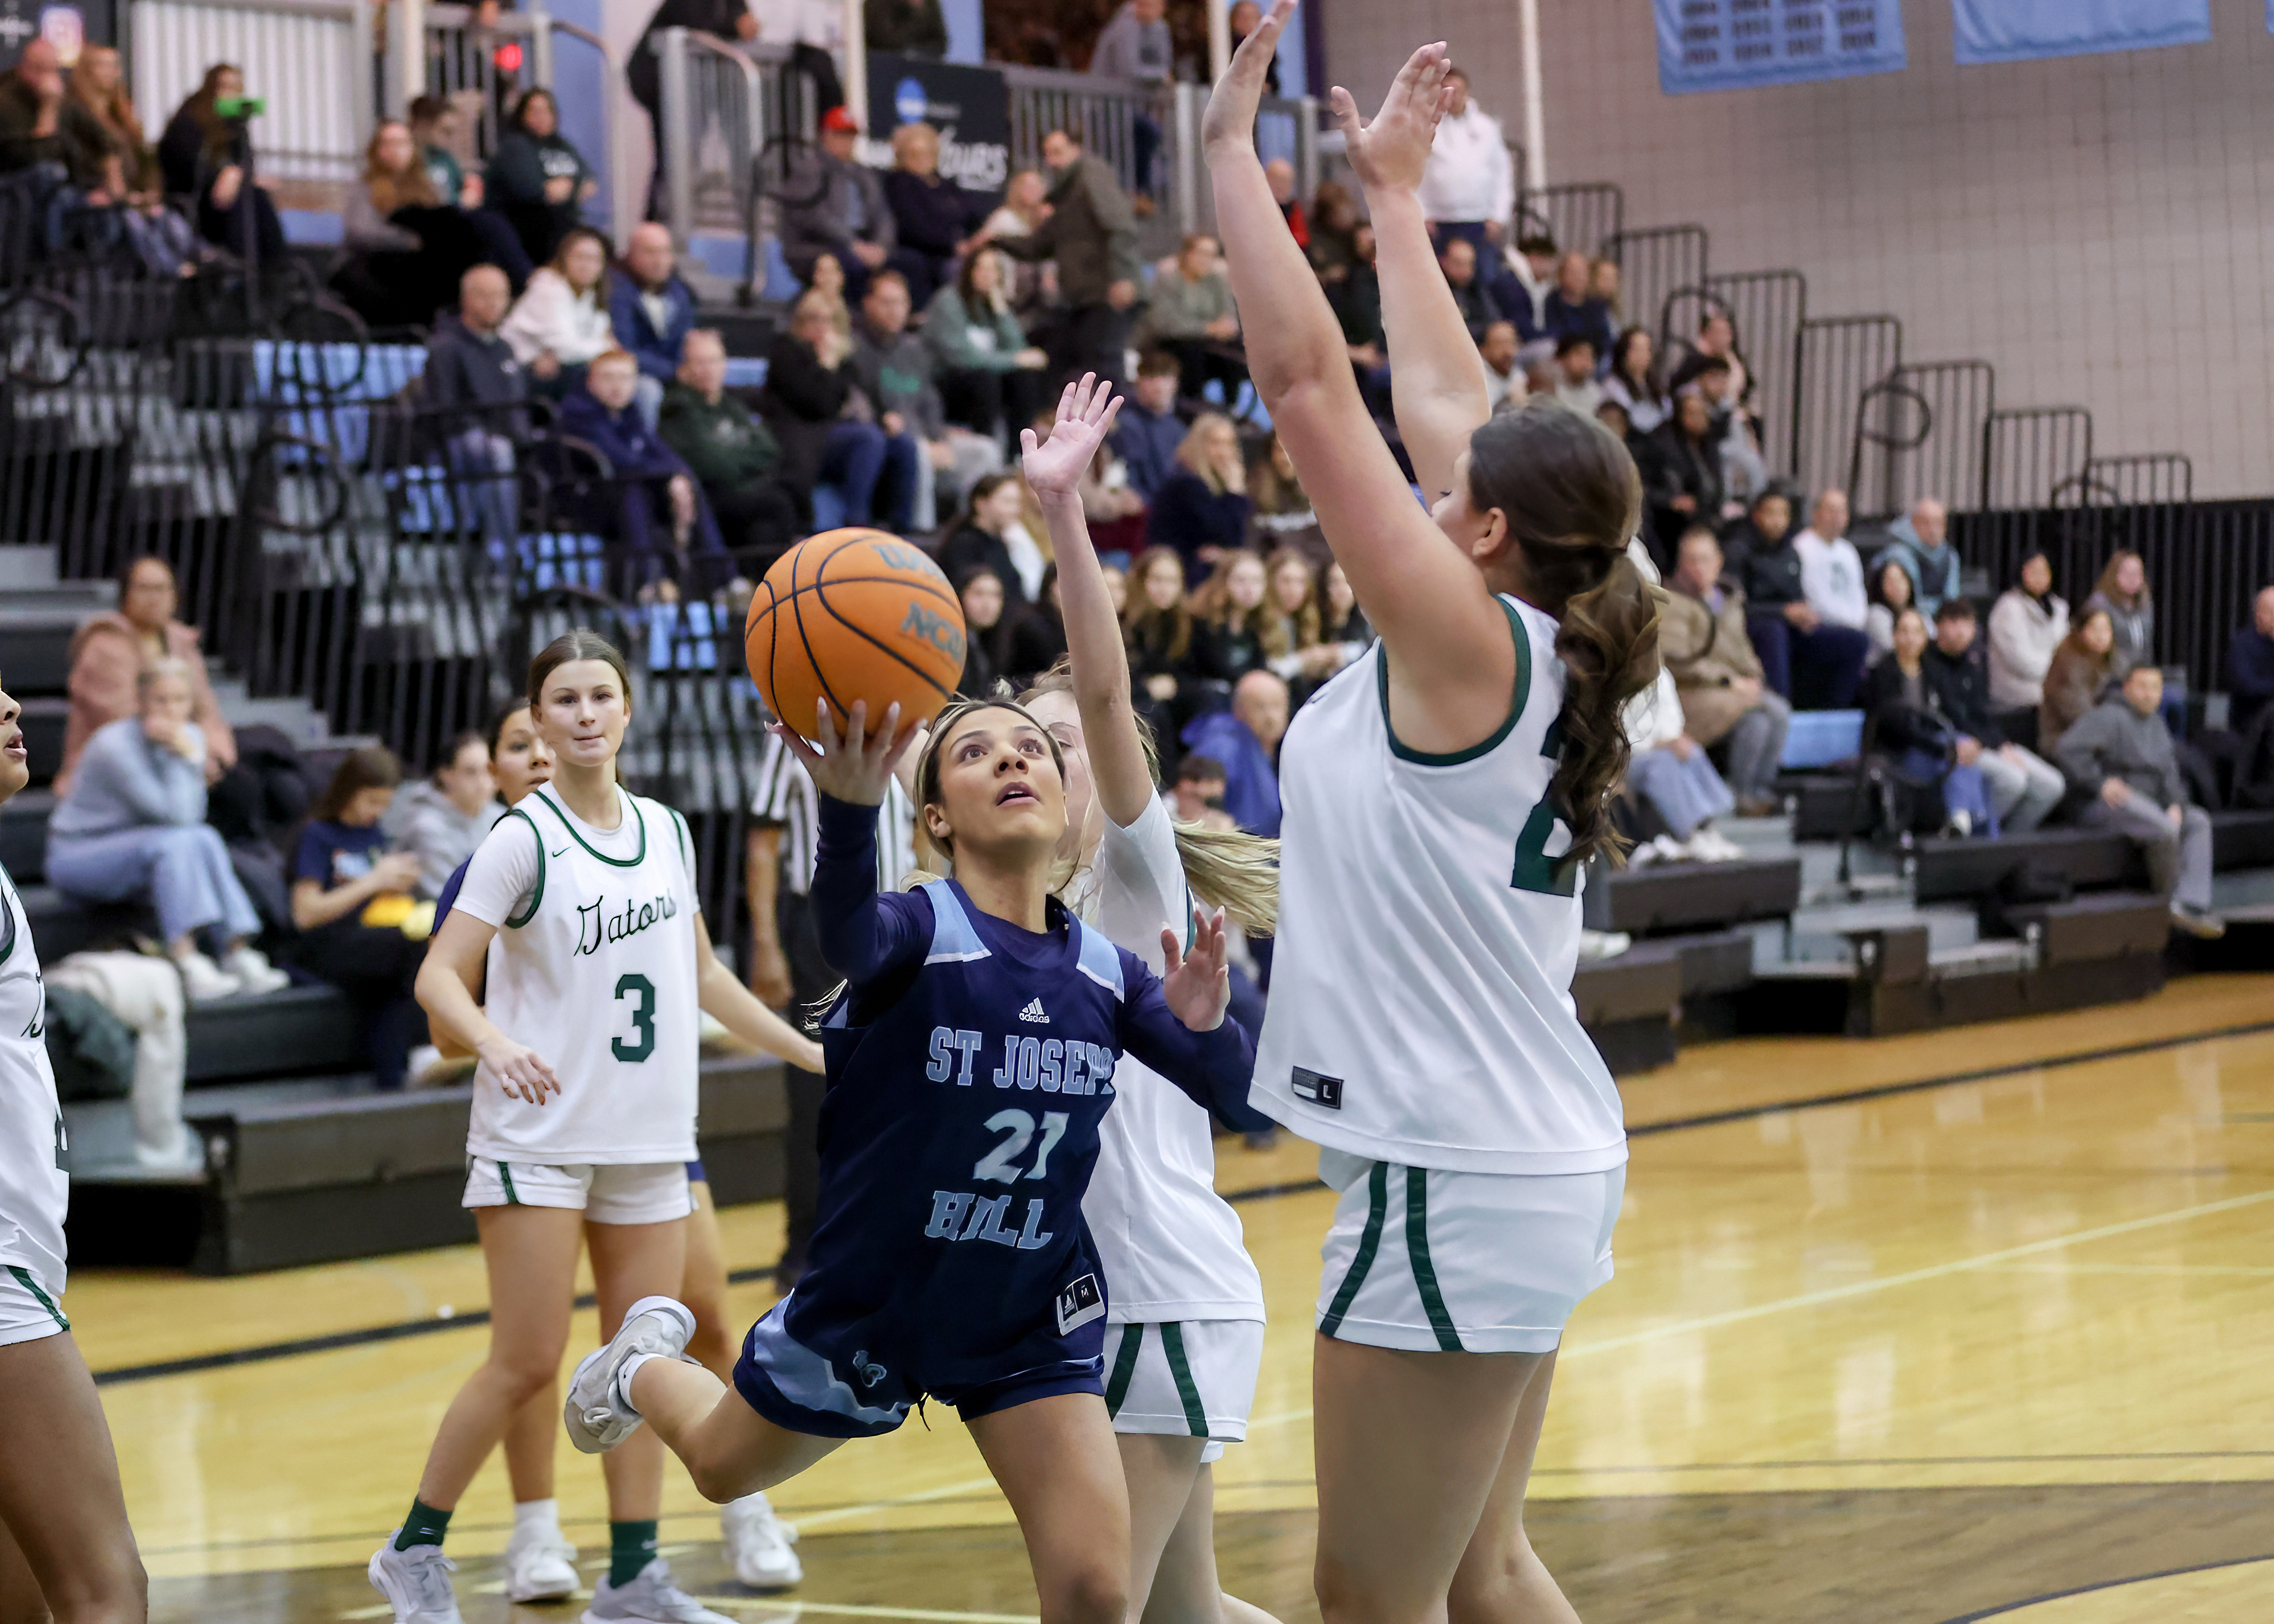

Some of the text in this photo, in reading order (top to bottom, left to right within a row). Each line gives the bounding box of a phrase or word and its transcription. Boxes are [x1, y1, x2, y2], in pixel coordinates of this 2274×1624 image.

[611, 974, 655, 1062] 3
[1019, 1012, 1050, 1024] adidas
[926, 1026, 982, 1085] ST
[1323, 1084, 1332, 1099] L
[973, 1108, 1070, 1185] 21
[924, 1190, 1054, 1249] HILL
